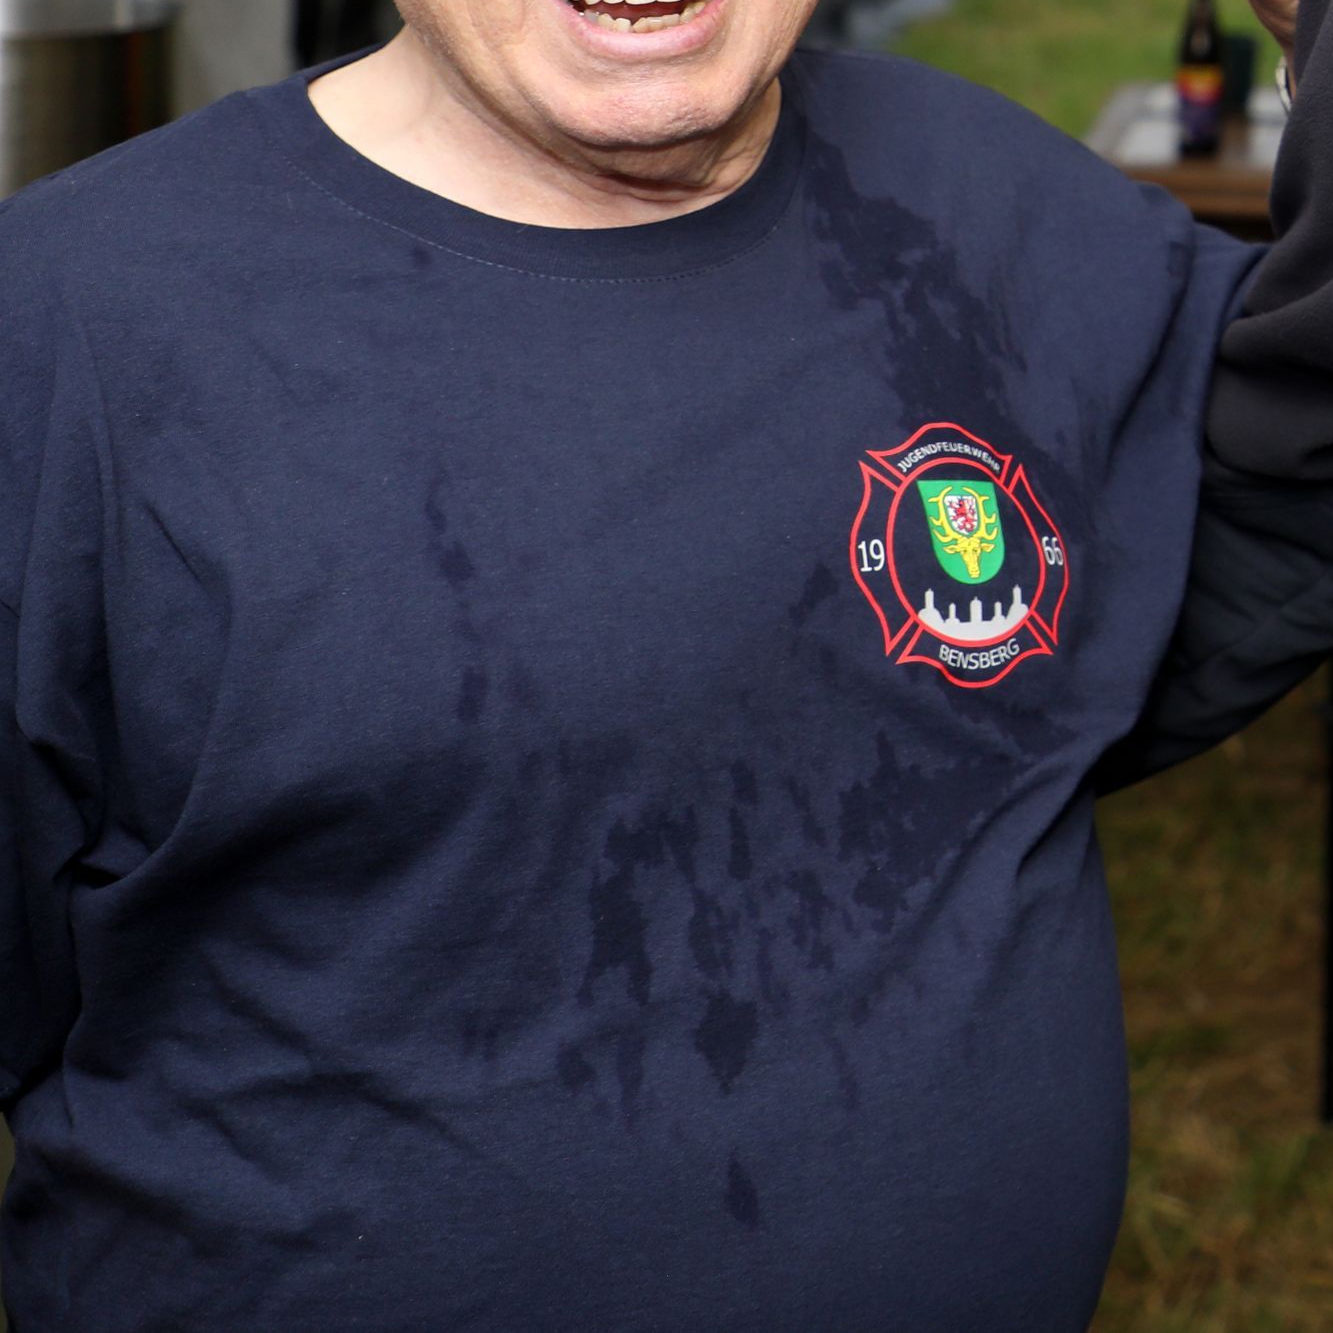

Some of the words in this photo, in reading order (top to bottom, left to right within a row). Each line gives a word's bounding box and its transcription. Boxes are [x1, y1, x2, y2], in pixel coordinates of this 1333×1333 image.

[897, 442, 1001, 473] JUGENDFEUERWEHR
[857, 539, 885, 572] 19
[1041, 536, 1064, 566] 66
[939, 638, 1020, 670] BENSBERG
